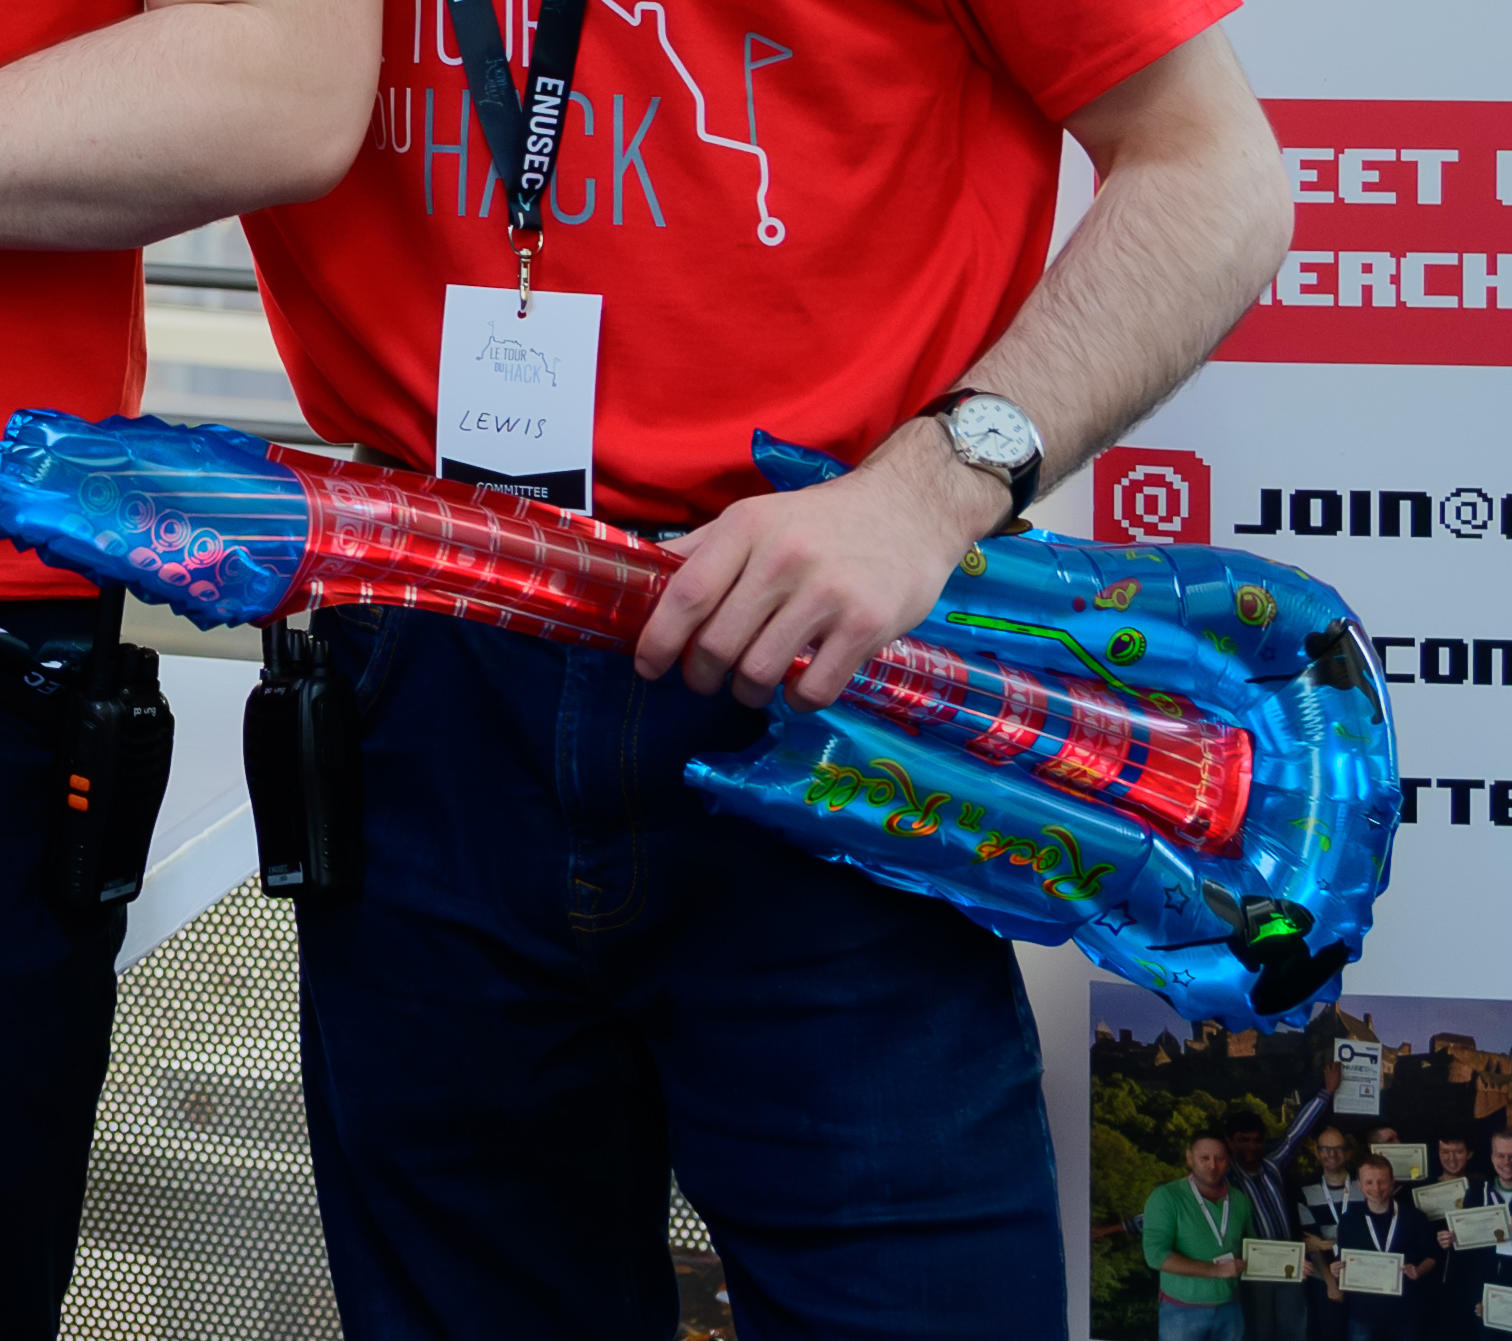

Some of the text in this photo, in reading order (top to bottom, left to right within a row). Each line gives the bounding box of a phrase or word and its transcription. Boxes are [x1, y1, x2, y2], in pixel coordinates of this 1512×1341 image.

[424, 87, 667, 228] HCK
[1280, 147, 1460, 205] EET
[1260, 249, 1512, 310] ERCH
[489, 346, 527, 362] LE TOUR
[504, 363, 543, 384] HACK
[459, 409, 547, 439] LEWIS
[1234, 486, 1512, 540] JOIN@
